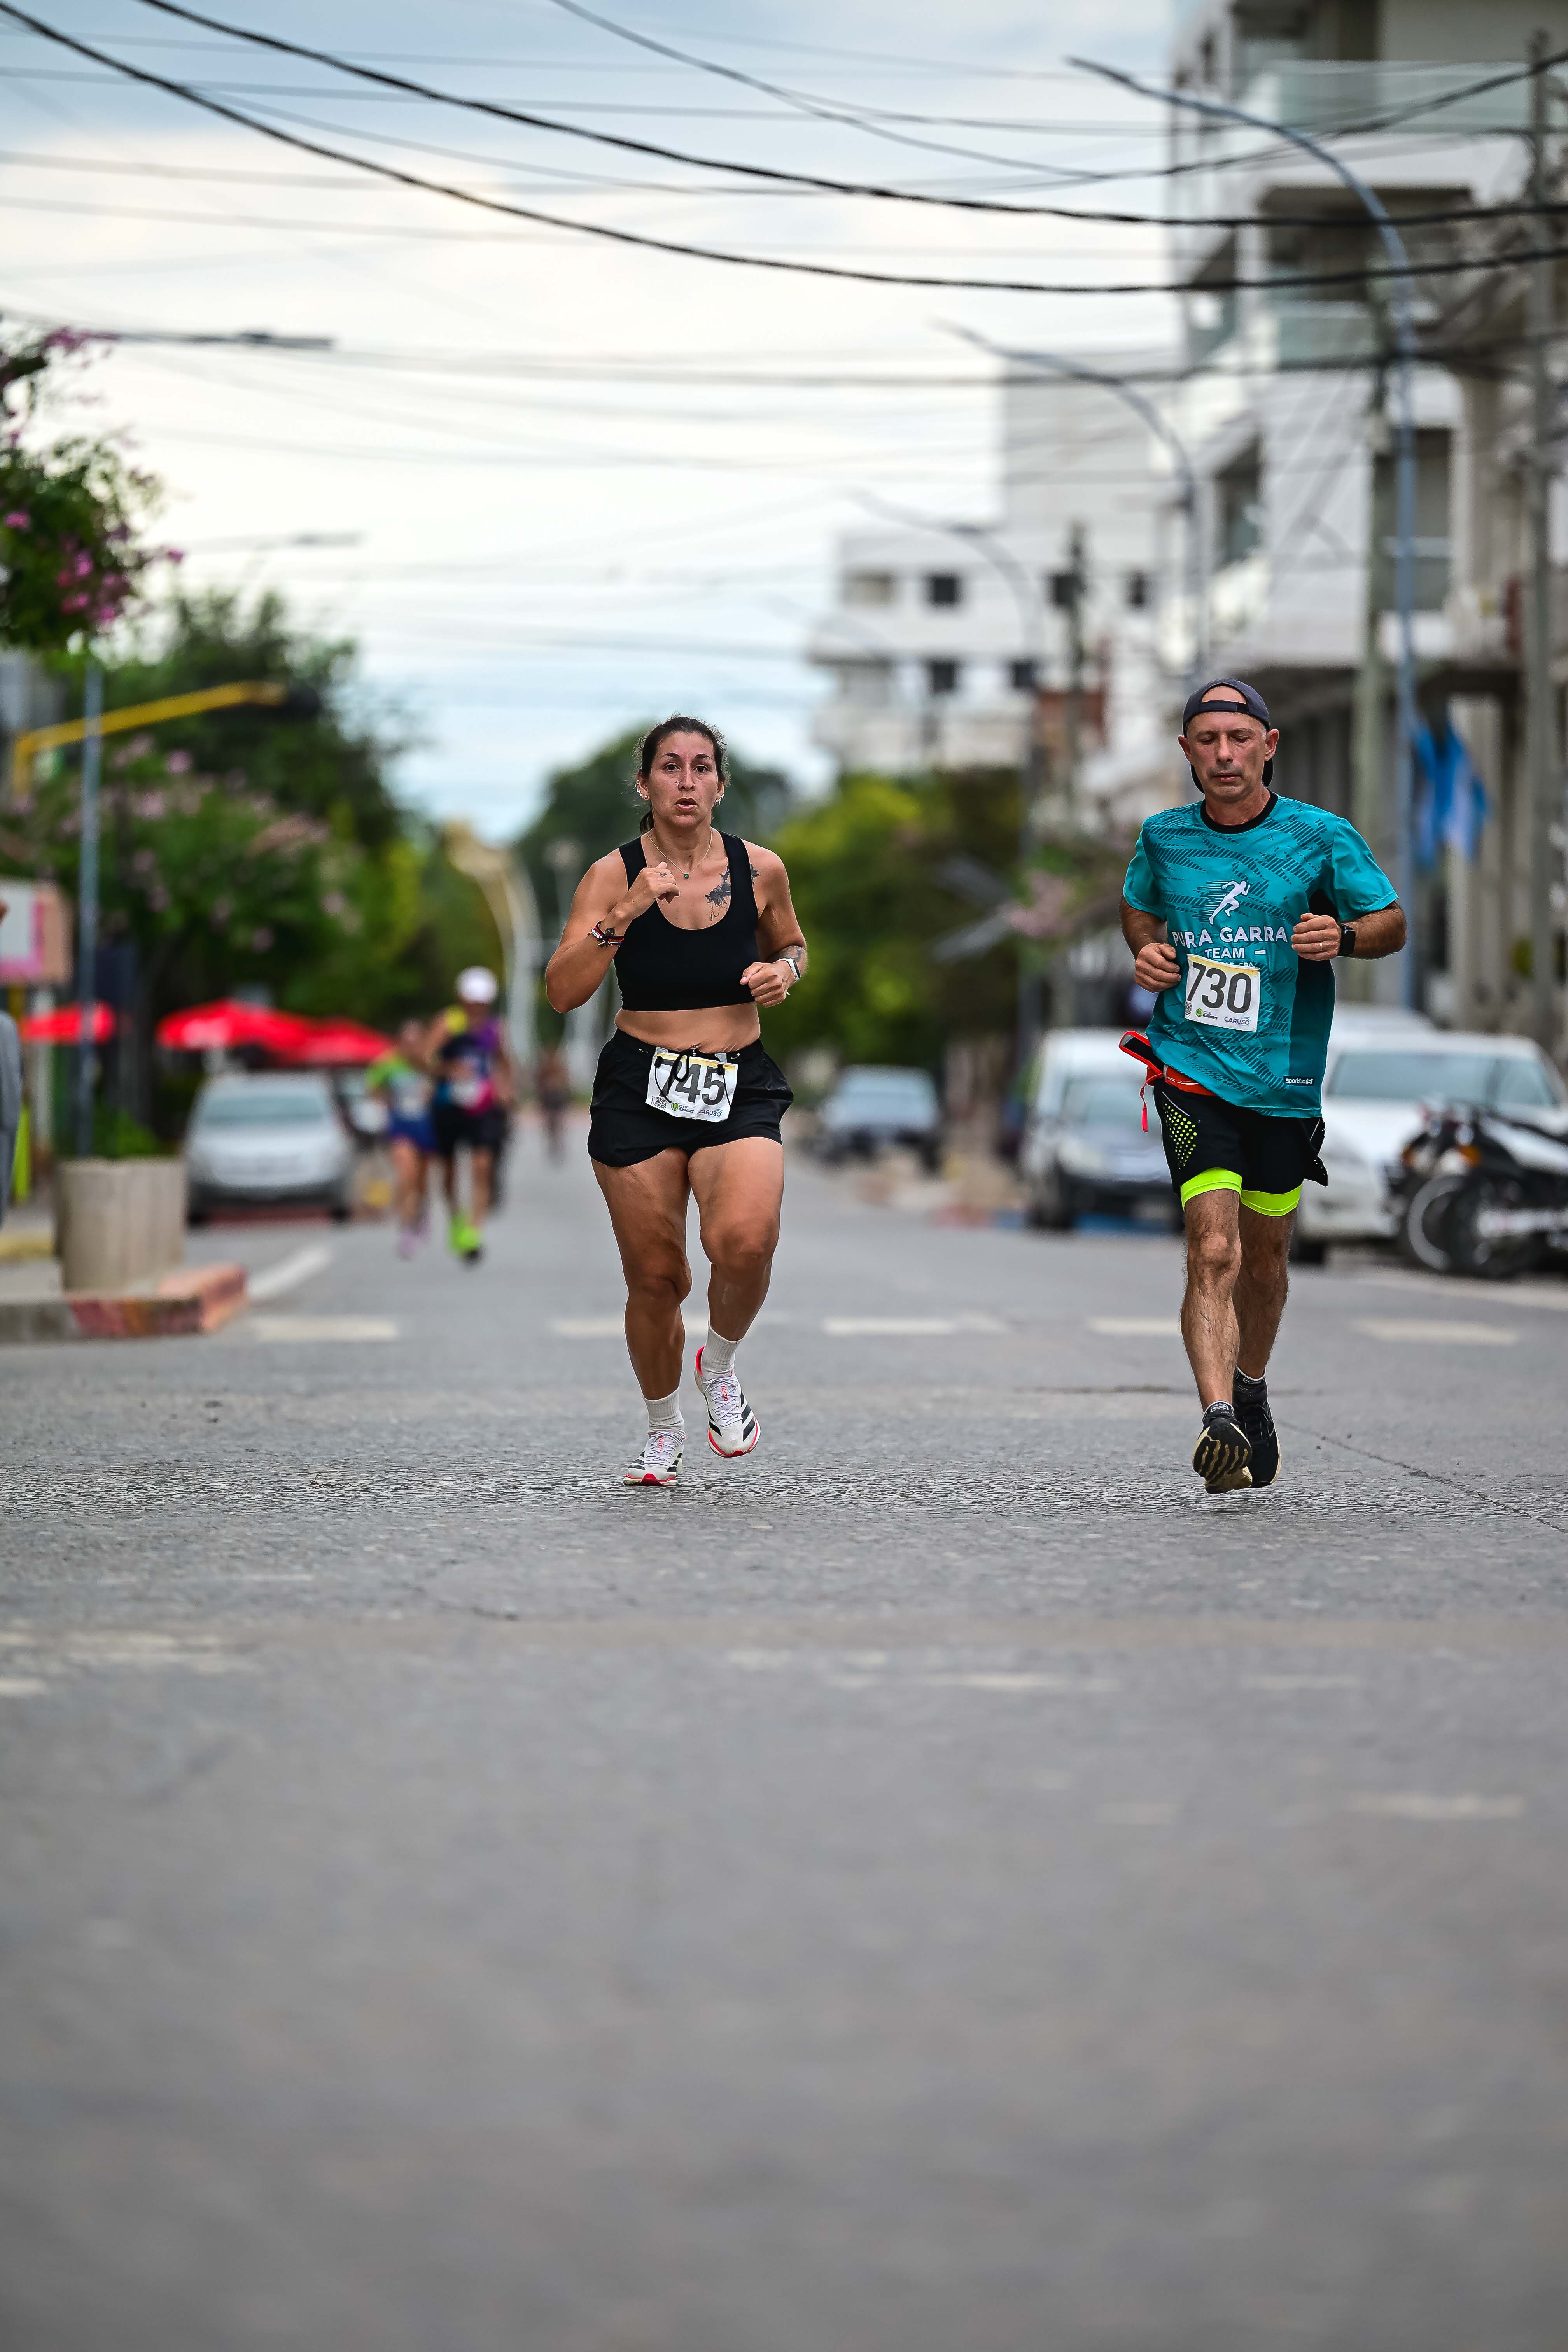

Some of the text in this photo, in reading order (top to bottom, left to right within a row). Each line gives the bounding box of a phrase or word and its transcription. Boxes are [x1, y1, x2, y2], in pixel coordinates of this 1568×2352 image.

[1172, 926, 1288, 948] PURA GARRA
[1204, 947, 1245, 959] TEAM
[1186, 961, 1252, 1013] 730
[1224, 1017, 1250, 1025] CARUSO
[659, 1059, 726, 1106] 745
[699, 1109, 722, 1117] CARUSO
